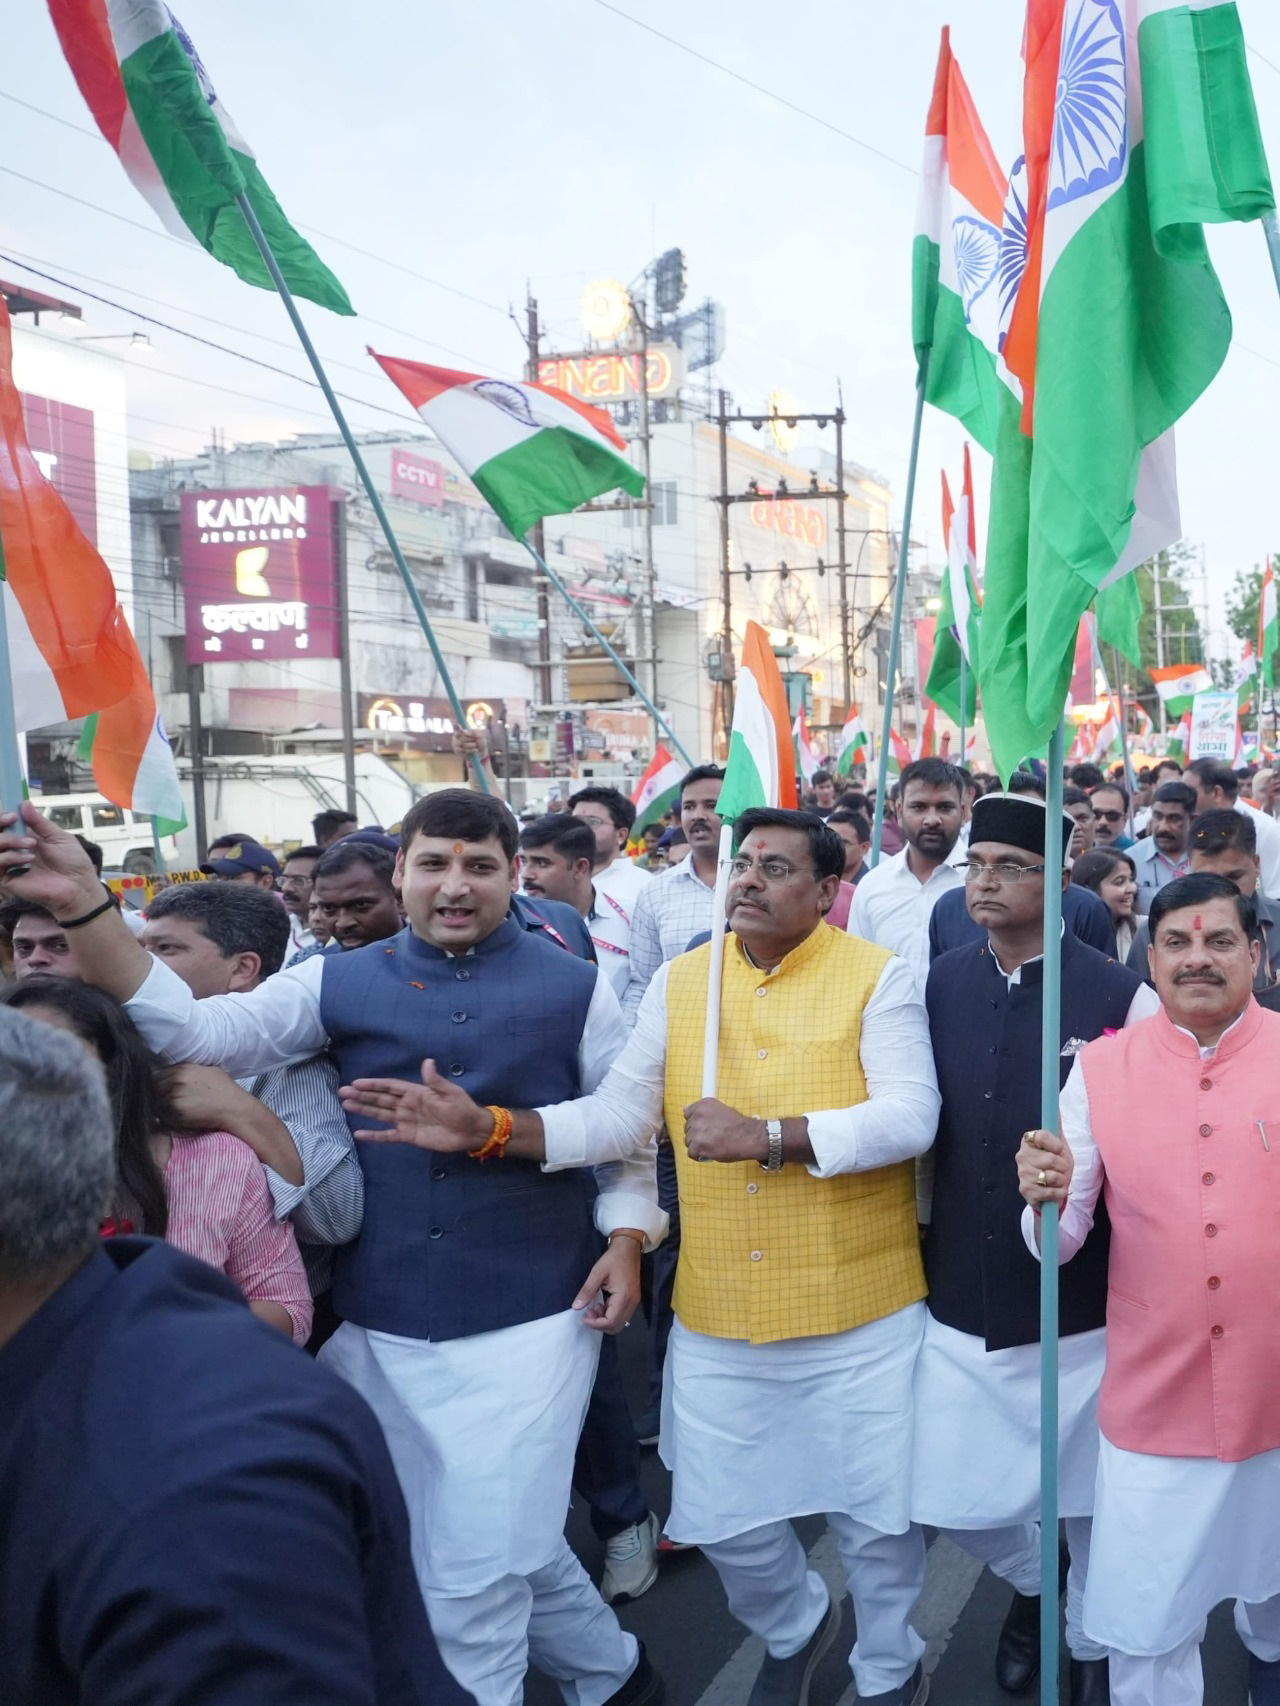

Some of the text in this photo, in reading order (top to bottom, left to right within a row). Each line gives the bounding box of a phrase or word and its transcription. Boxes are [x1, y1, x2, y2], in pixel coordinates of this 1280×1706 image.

[396, 462, 438, 487] CCTV
[197, 495, 307, 528] KALYAN
[201, 602, 309, 633] कल्याण
